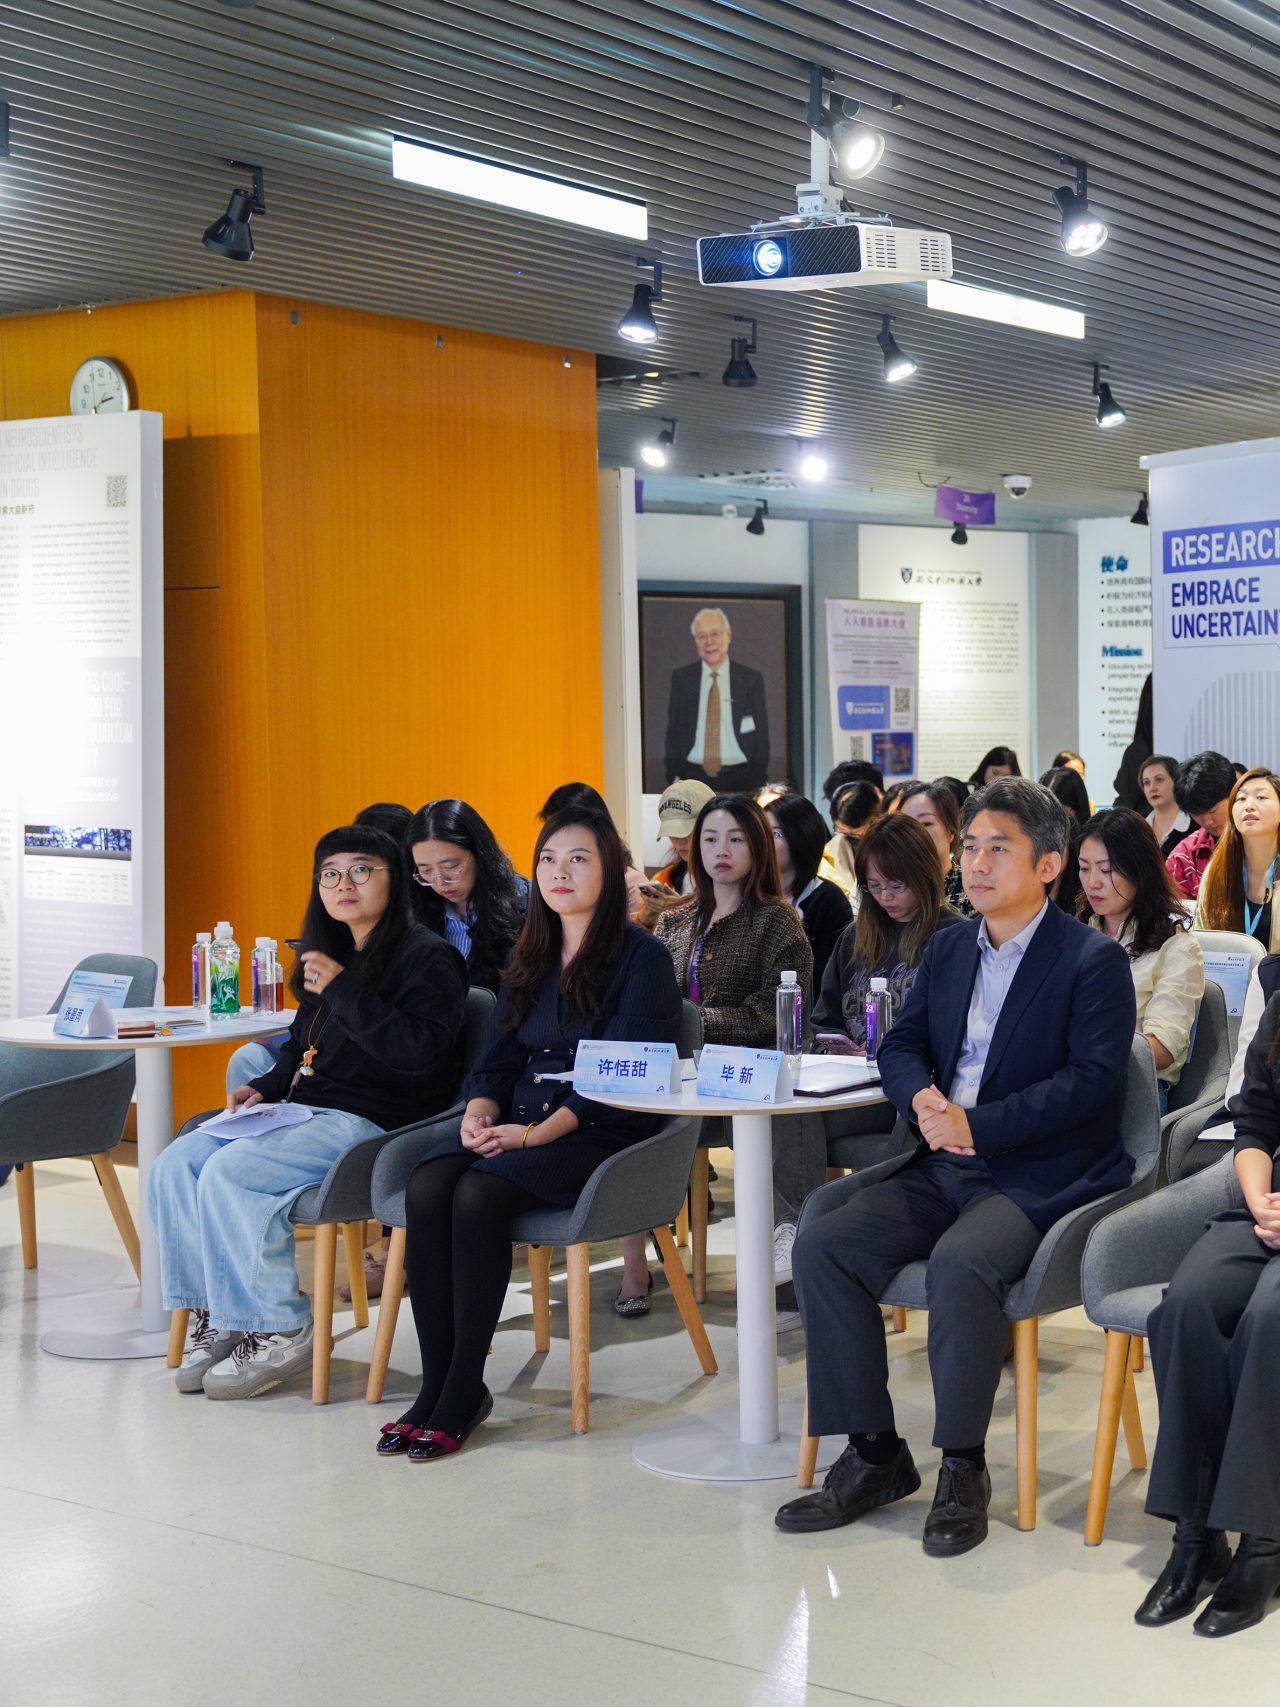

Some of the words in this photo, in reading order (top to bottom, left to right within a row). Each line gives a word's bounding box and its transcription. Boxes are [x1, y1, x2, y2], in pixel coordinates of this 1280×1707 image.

[38, 448, 98, 471] INTELLIGENCE
[1101, 555, 1128, 573] 使命
[1171, 577, 1260, 608] EMBRACE
[1102, 645, 1142, 656] Mission
[598, 1058, 648, 1077] 许恬甜
